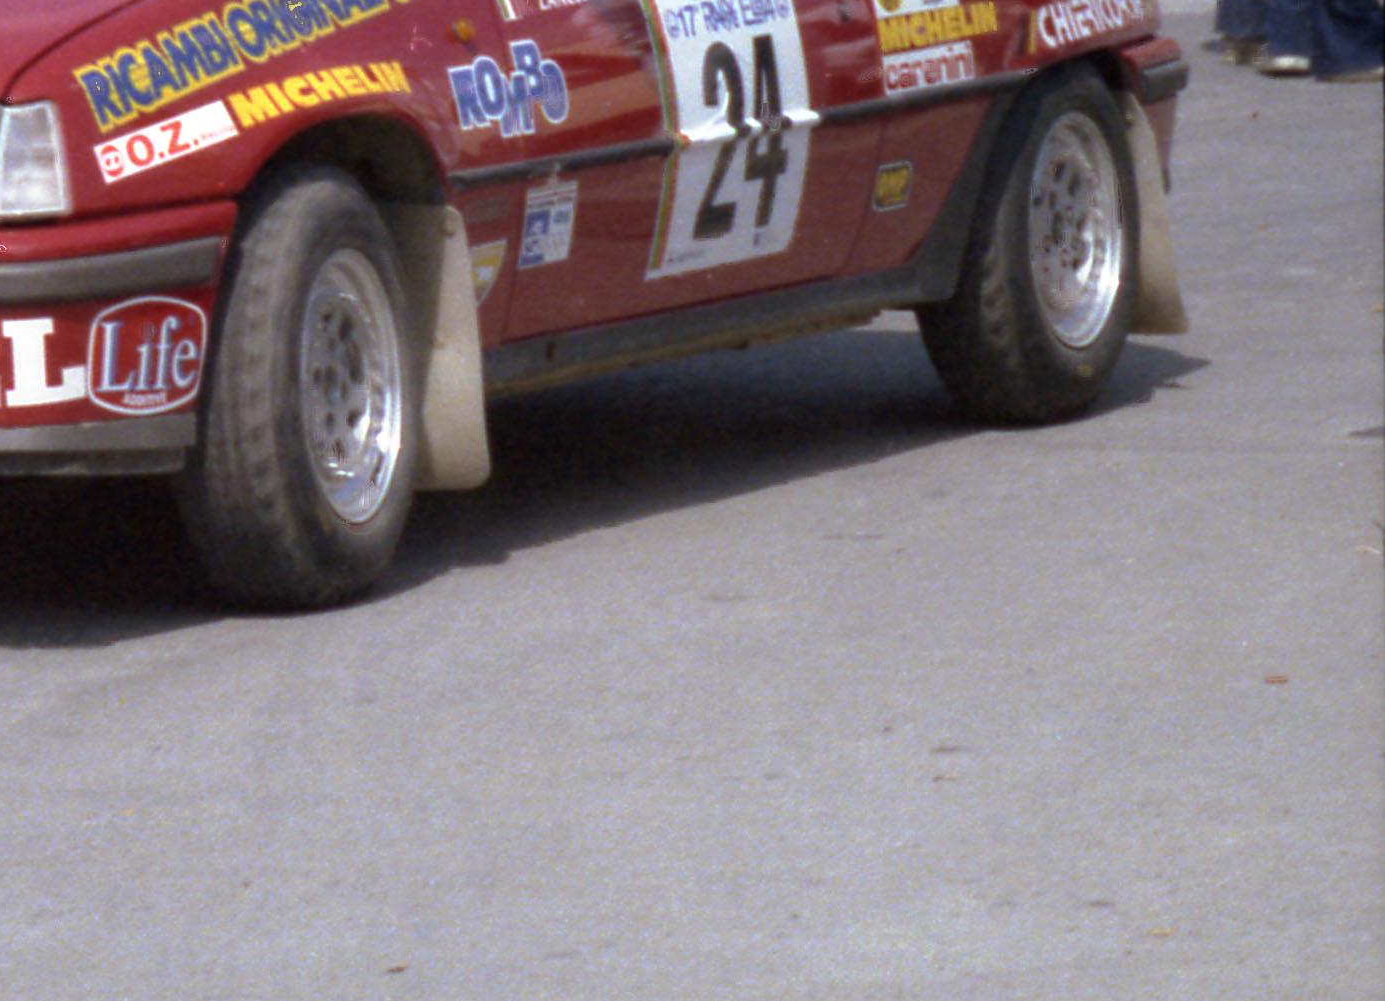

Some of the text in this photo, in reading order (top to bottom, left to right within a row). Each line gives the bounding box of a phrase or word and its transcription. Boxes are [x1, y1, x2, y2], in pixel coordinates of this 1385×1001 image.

[76, 13, 243, 130] RICAMBI
[878, 0, 999, 53] MICHELIN
[227, 61, 412, 128] MICHELIN
[447, 39, 569, 138] ROMBO
[692, 33, 794, 241] 24
[94, 313, 198, 394] Life
